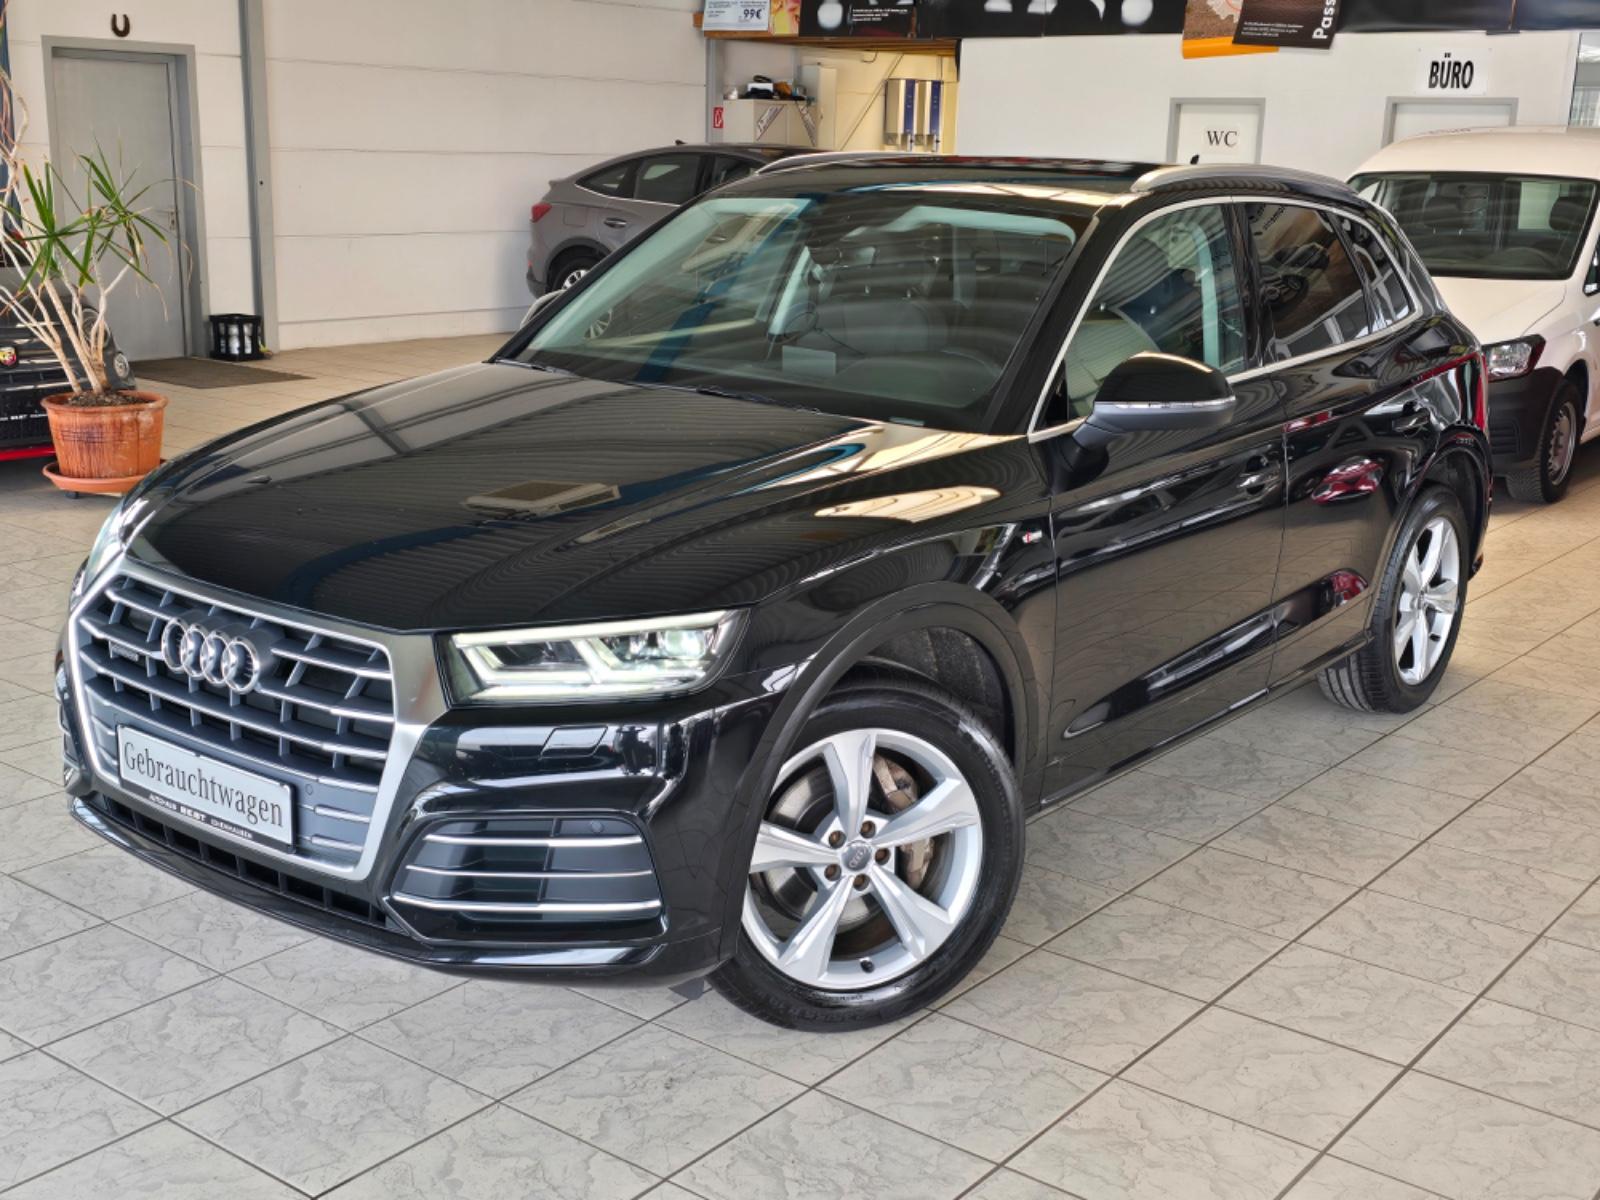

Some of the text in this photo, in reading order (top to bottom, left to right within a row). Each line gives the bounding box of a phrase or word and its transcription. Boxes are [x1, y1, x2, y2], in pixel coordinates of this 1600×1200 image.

[1428, 52, 1475, 89] BÜRO
[1207, 130, 1238, 148] WC
[123, 741, 283, 828] Gebrauchtwagen
